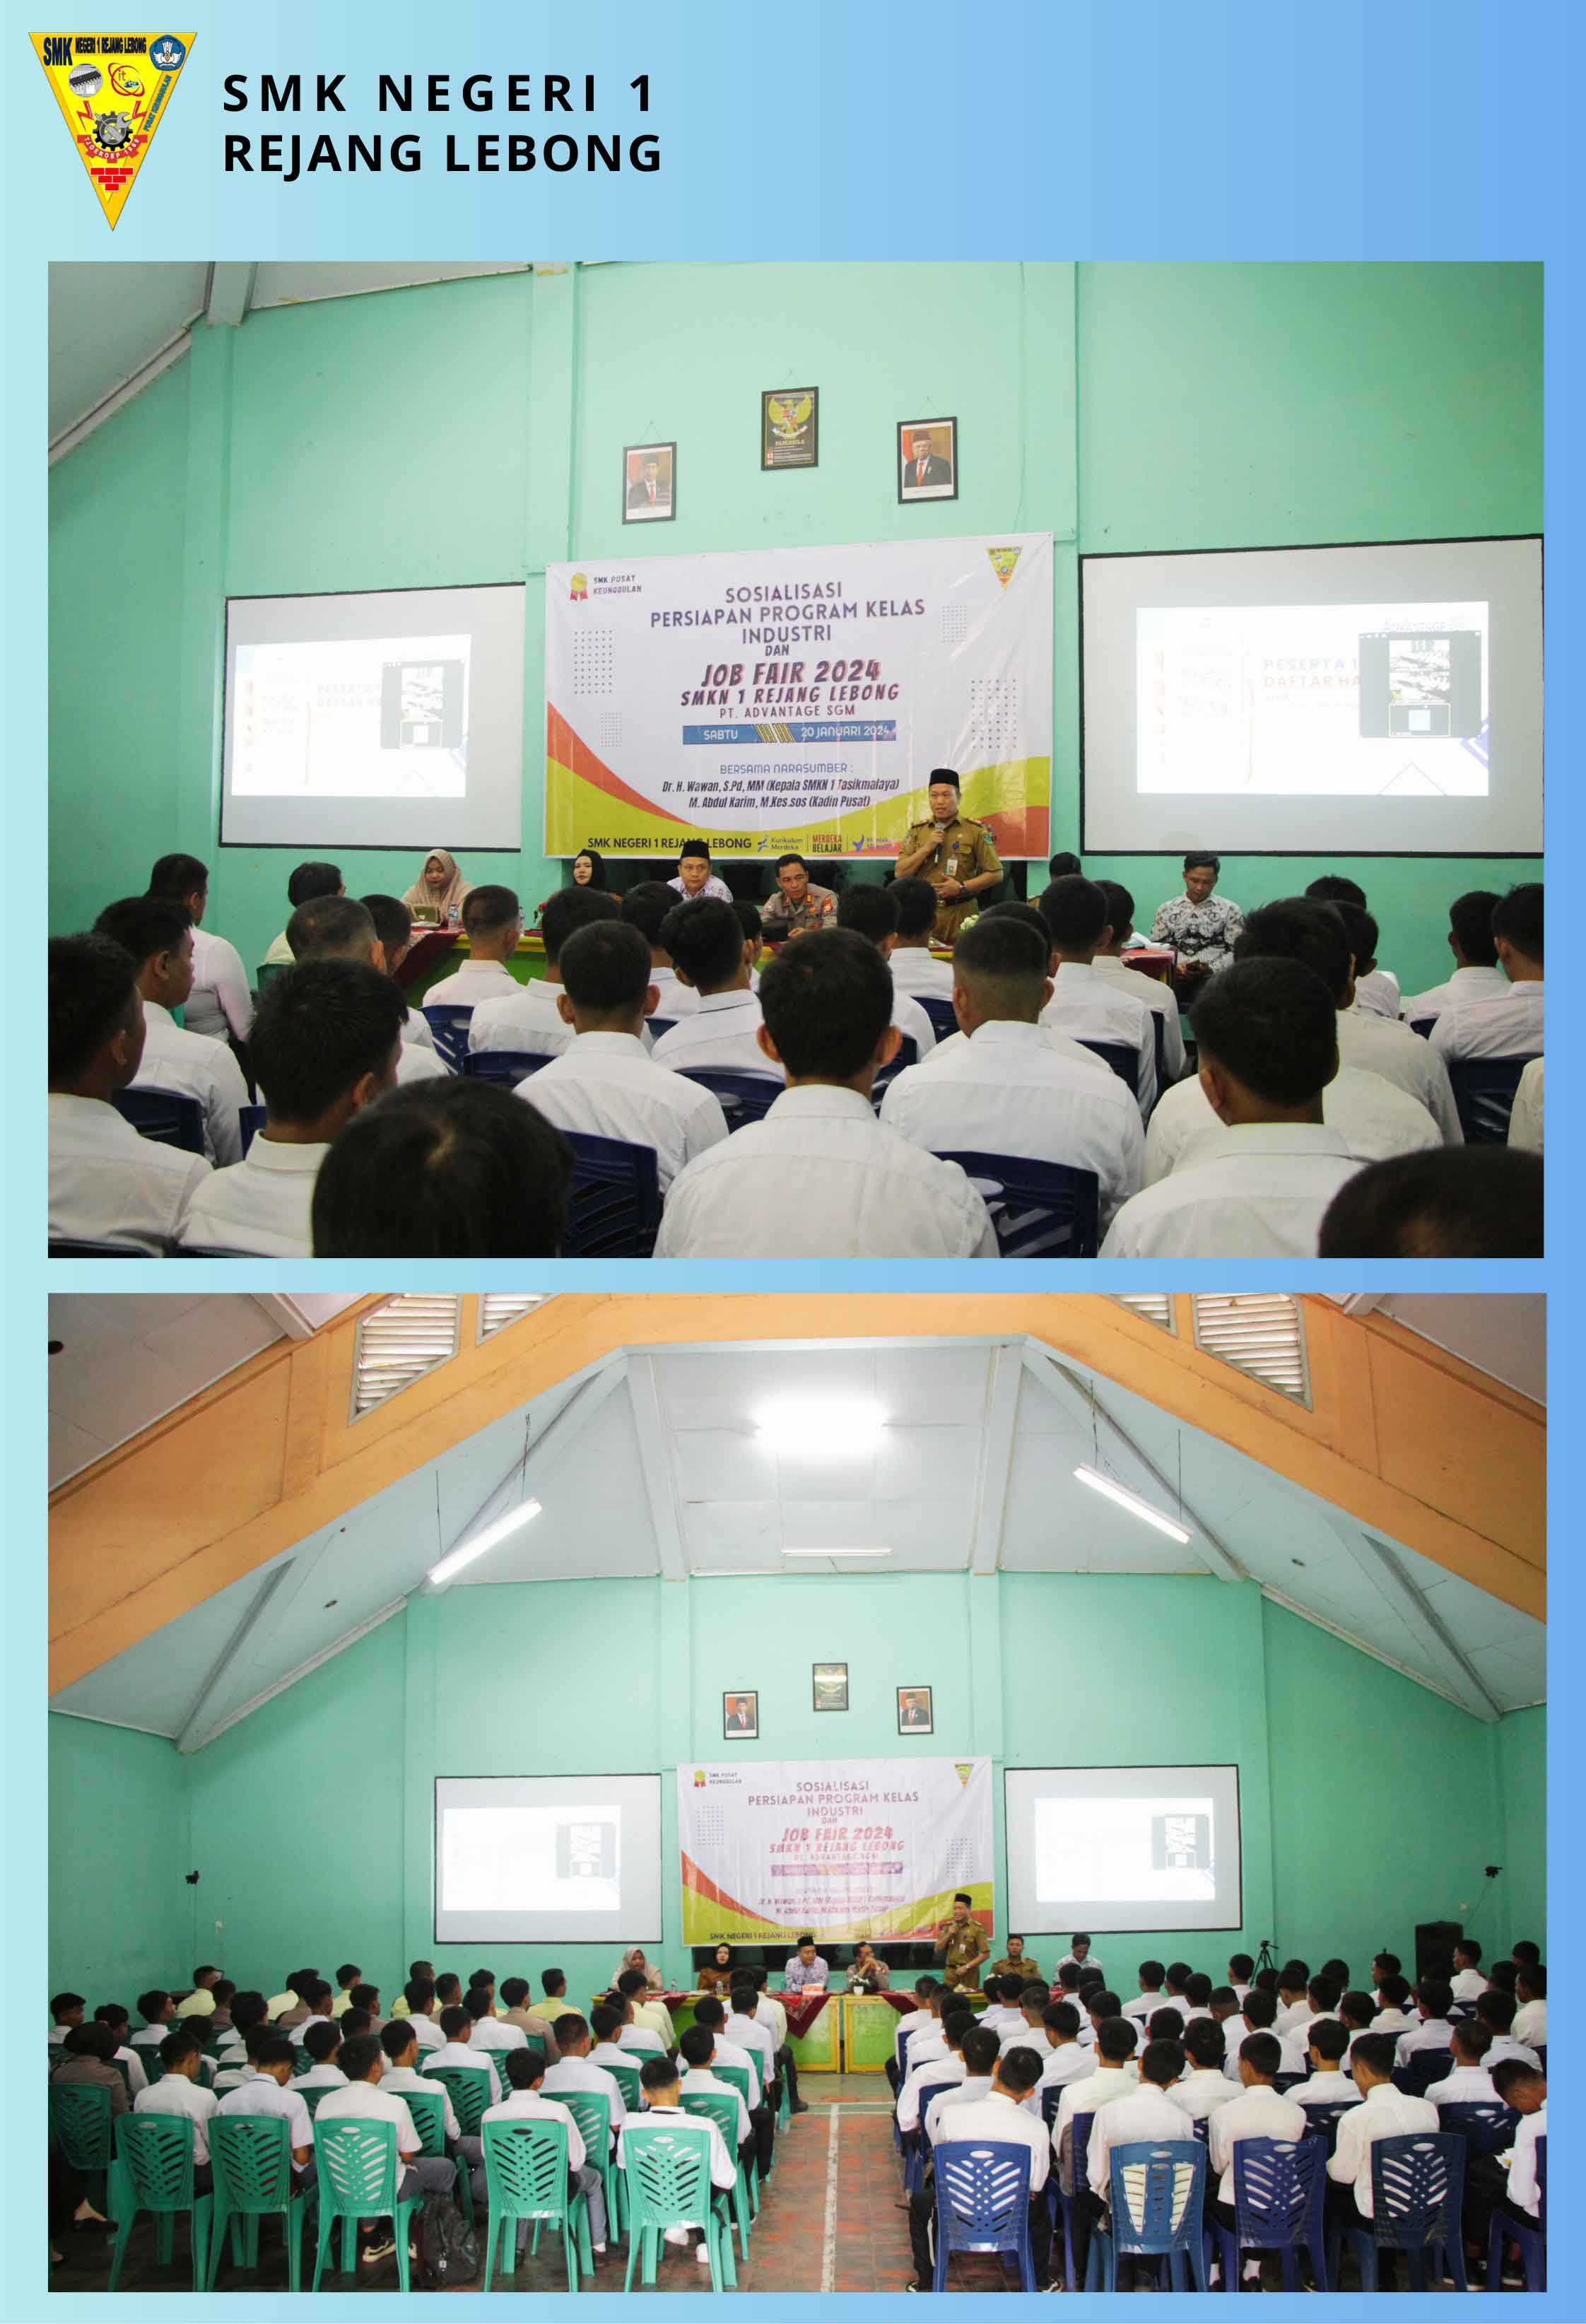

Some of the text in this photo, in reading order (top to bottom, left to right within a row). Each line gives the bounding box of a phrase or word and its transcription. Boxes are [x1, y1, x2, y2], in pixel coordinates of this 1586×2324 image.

[725, 582, 842, 603] SOSIALISASI
[651, 599, 925, 628] PERSIAPAN PROGRAM KELAS
[742, 624, 831, 644] INDUSTRI
[765, 644, 789, 657] DAN
[701, 659, 881, 687] JOB FAIR 2024
[681, 683, 899, 706] SMKN 1 REJANG LEBONG
[719, 705, 855, 719] PT. ADVANTAGE SGM
[703, 725, 888, 740] SABTU 20 JANUARI 2024
[662, 781, 675, 792] Dr.
[747, 780, 765, 792] MM
[766, 779, 801, 792] (Kepala
[802, 779, 828, 791] SMKN
[830, 779, 835, 791] 1
[837, 778, 900, 792] Tasikmalaya)
[689, 797, 700, 809] M.
[702, 797, 727, 808] Abdul
[729, 797, 758, 809] Karim,
[809, 795, 839, 808] (Kadin
[840, 795, 871, 807] Pusat)
[588, 837, 752, 848] SMK NEGERI 1 REJA LEBONG
[813, 834, 842, 843] MERDEKA
[813, 843, 842, 852] BELAJAR
[797, 1781, 869, 1792] SOSIALISASI
[748, 1792, 919, 1806] PERSIAPAN PROGRAM KELAS
[807, 1806, 864, 1817] INDUSTRI
[782, 1827, 809, 1842] JOB
